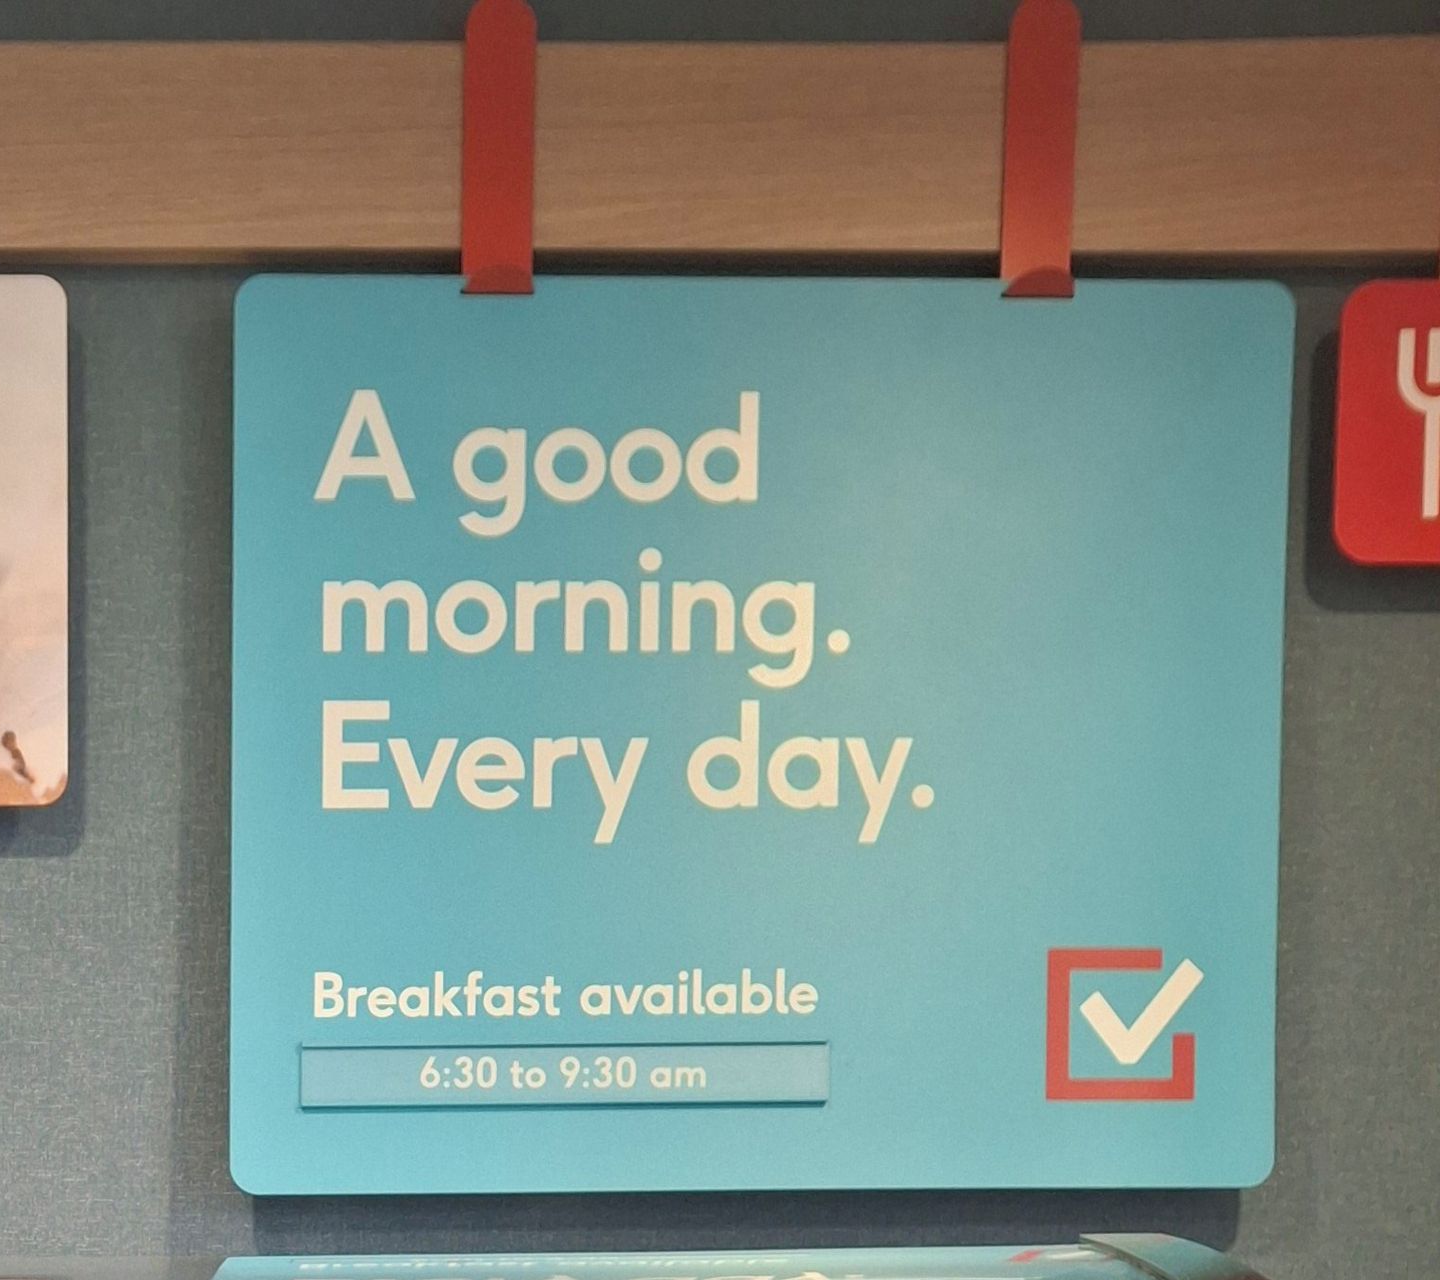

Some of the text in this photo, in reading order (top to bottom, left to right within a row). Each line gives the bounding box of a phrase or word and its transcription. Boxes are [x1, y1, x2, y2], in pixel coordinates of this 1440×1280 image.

[313, 388, 761, 539] A good
[321, 545, 852, 692] morning.
[320, 698, 936, 847] Every day.
[312, 966, 820, 1020] Breakfast available
[418, 1054, 708, 1090] 6:30 to 9:30 am
